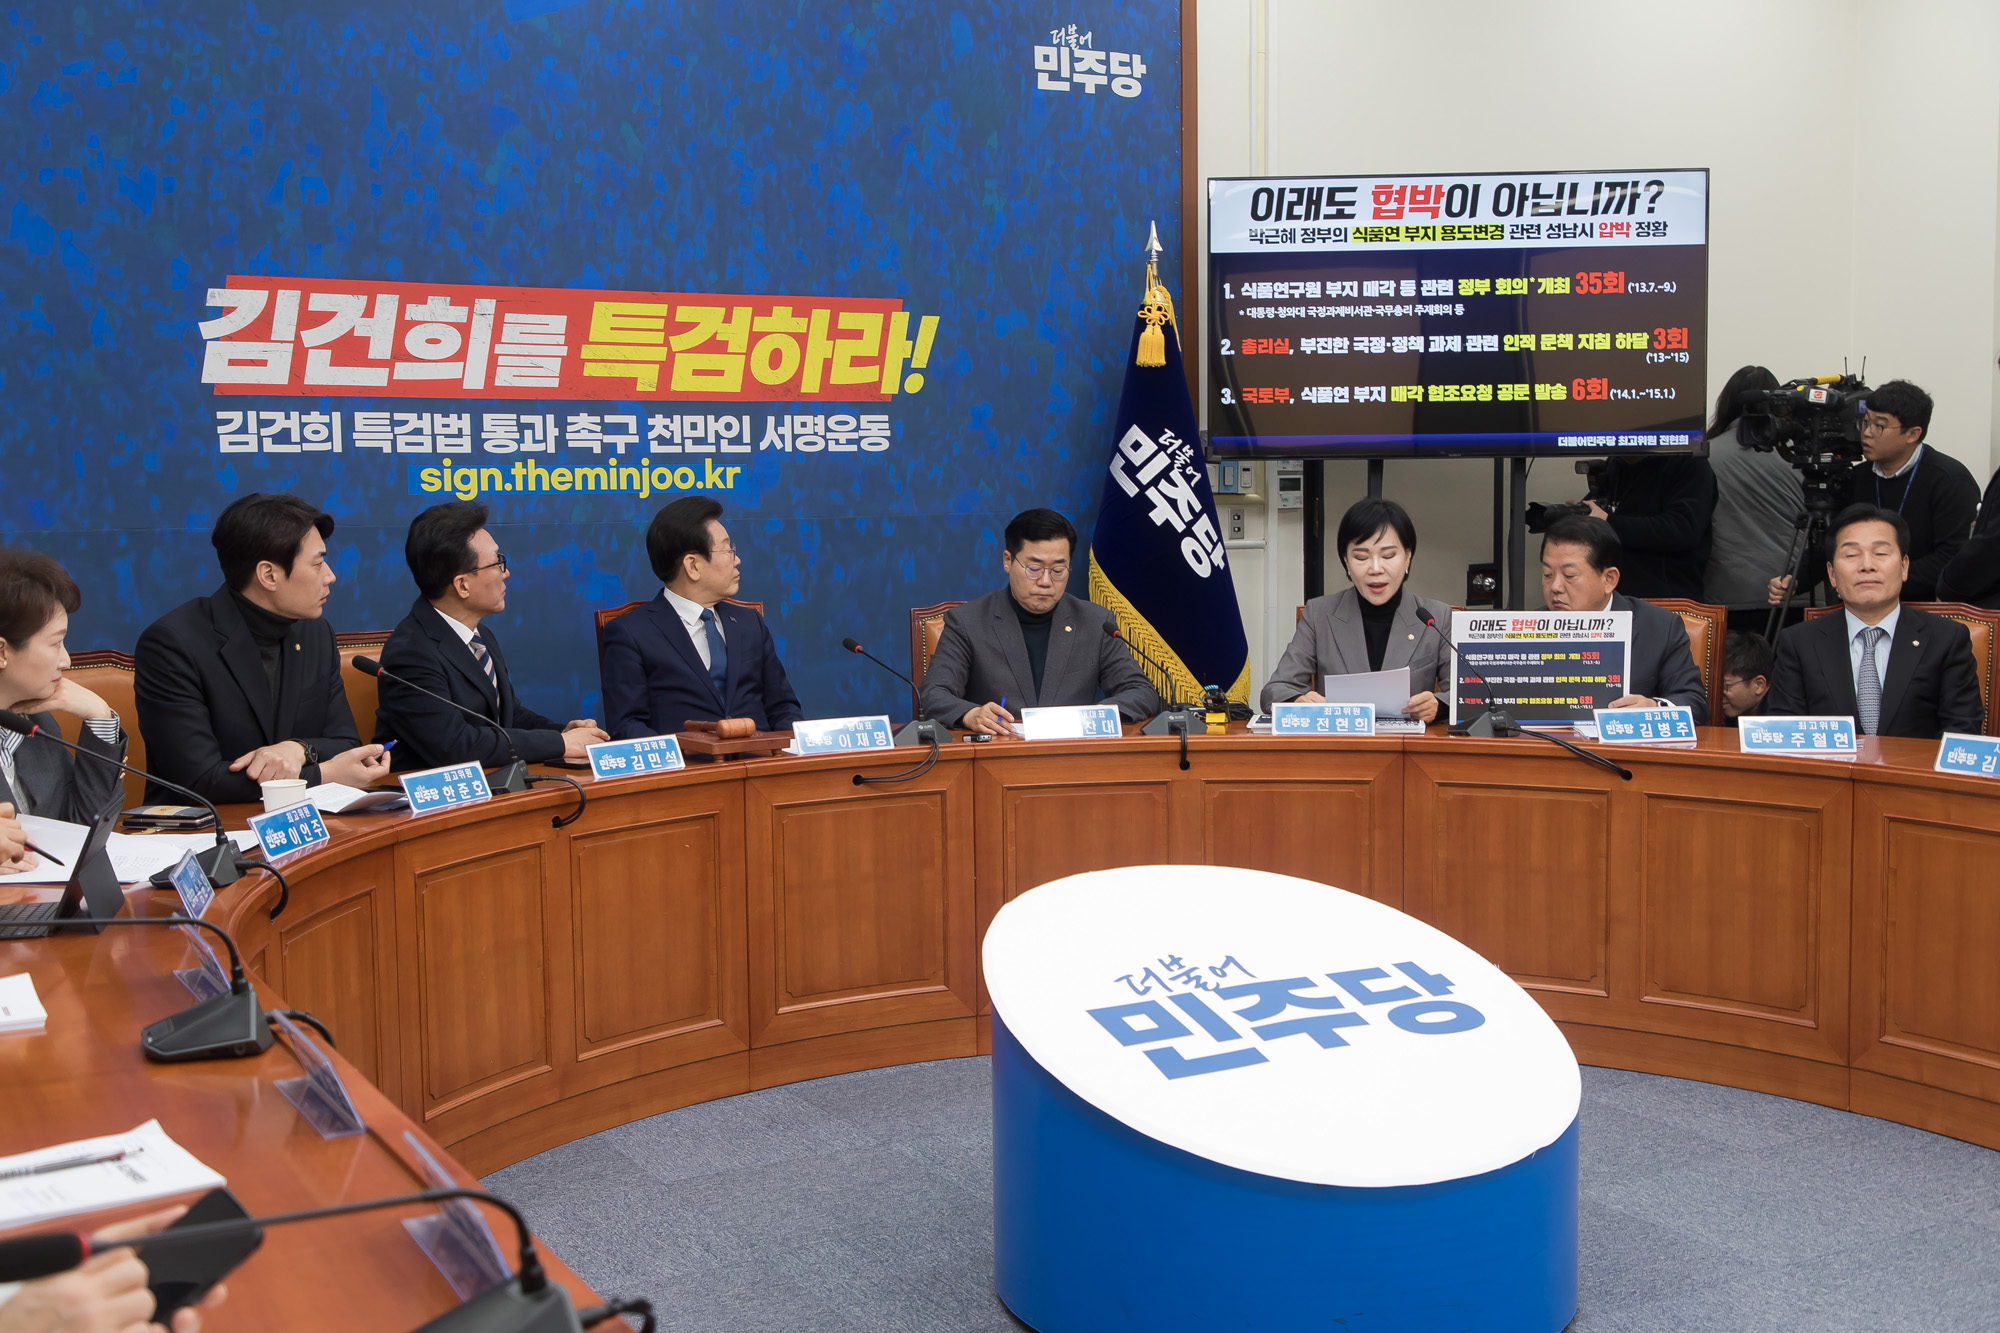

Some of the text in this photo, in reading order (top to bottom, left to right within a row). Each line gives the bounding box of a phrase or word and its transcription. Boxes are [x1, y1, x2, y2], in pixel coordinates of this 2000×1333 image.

[1050, 24, 1092, 50] 더불어
[1034, 45, 1147, 98] 민주당
[1250, 179, 1665, 222] 이래도 협박이 아닙니까?
[1249, 221, 1669, 245] 박근혜 정부의 식품연 부지 용도변경 관련 성남시 압박 정황
[1223, 282, 1235, 299] 1.
[1241, 281, 1322, 299] 식품연구원
[1326, 281, 1358, 298] 부지
[1363, 280, 1396, 297] 매각
[1400, 280, 1416, 297] 등
[1421, 279, 1453, 296] 관련
[1458, 278, 1491, 296] 정부
[1537, 277, 1570, 295] 개최
[1575, 271, 1625, 295] 35회
[1414, 304, 1452, 316] 주재회의
[1454, 304, 1465, 316] 등
[198, 287, 940, 395] 김건희를 특검하라!
[1220, 327, 1688, 355] 2. 총리실, 부진한 국정·정책 과제 관련 인적 문책 지침 하달 3회
[1220, 387, 1235, 404] 3.
[1242, 387, 1295, 404] 국토부,
[1301, 386, 1349, 403] 식품연
[1354, 386, 1386, 403] 부지
[1391, 385, 1424, 402] 매각
[1428, 384, 1493, 402] 협조요청
[1497, 384, 1529, 401] 공문
[1534, 383, 1567, 400] 발송
[1572, 378, 1608, 400] 6회
[216, 411, 891, 454] 김건희 특검법 통과 촉구 천만인 서명운동
[1557, 436, 1616, 447] 더불어민주당
[1618, 435, 1657, 446] 최고위원
[1158, 428, 1201, 487] 더불어
[420, 458, 741, 501] sign.theminjoo.kr
[1109, 424, 1225, 578] 민주당
[1469, 618, 1614, 631] 이래도 협박이 아닙니까?
[1323, 707, 1360, 715] 최고위원
[1644, 711, 1679, 721] 최고위원
[1281, 717, 1310, 728] 민주당
[1316, 717, 1368, 732] 전현희
[1605, 722, 1689, 738] 민주당 김병주
[1798, 721, 1839, 730] 최고위원
[633, 740, 667, 752] 최고위원
[839, 731, 887, 748] 이재명
[1751, 732, 1849, 748] 민주당 주철현
[599, 751, 678, 771] 민주당 김민석
[1947, 751, 1977, 766] 민주당
[443, 768, 473, 782] 최고위원
[413, 780, 486, 803] 민주당 한준호
[286, 807, 311, 823] 최고위원
[264, 819, 323, 849] 민주당 이언주
[1114, 954, 1258, 997] 더불어
[1085, 961, 1486, 1080] 민주당
